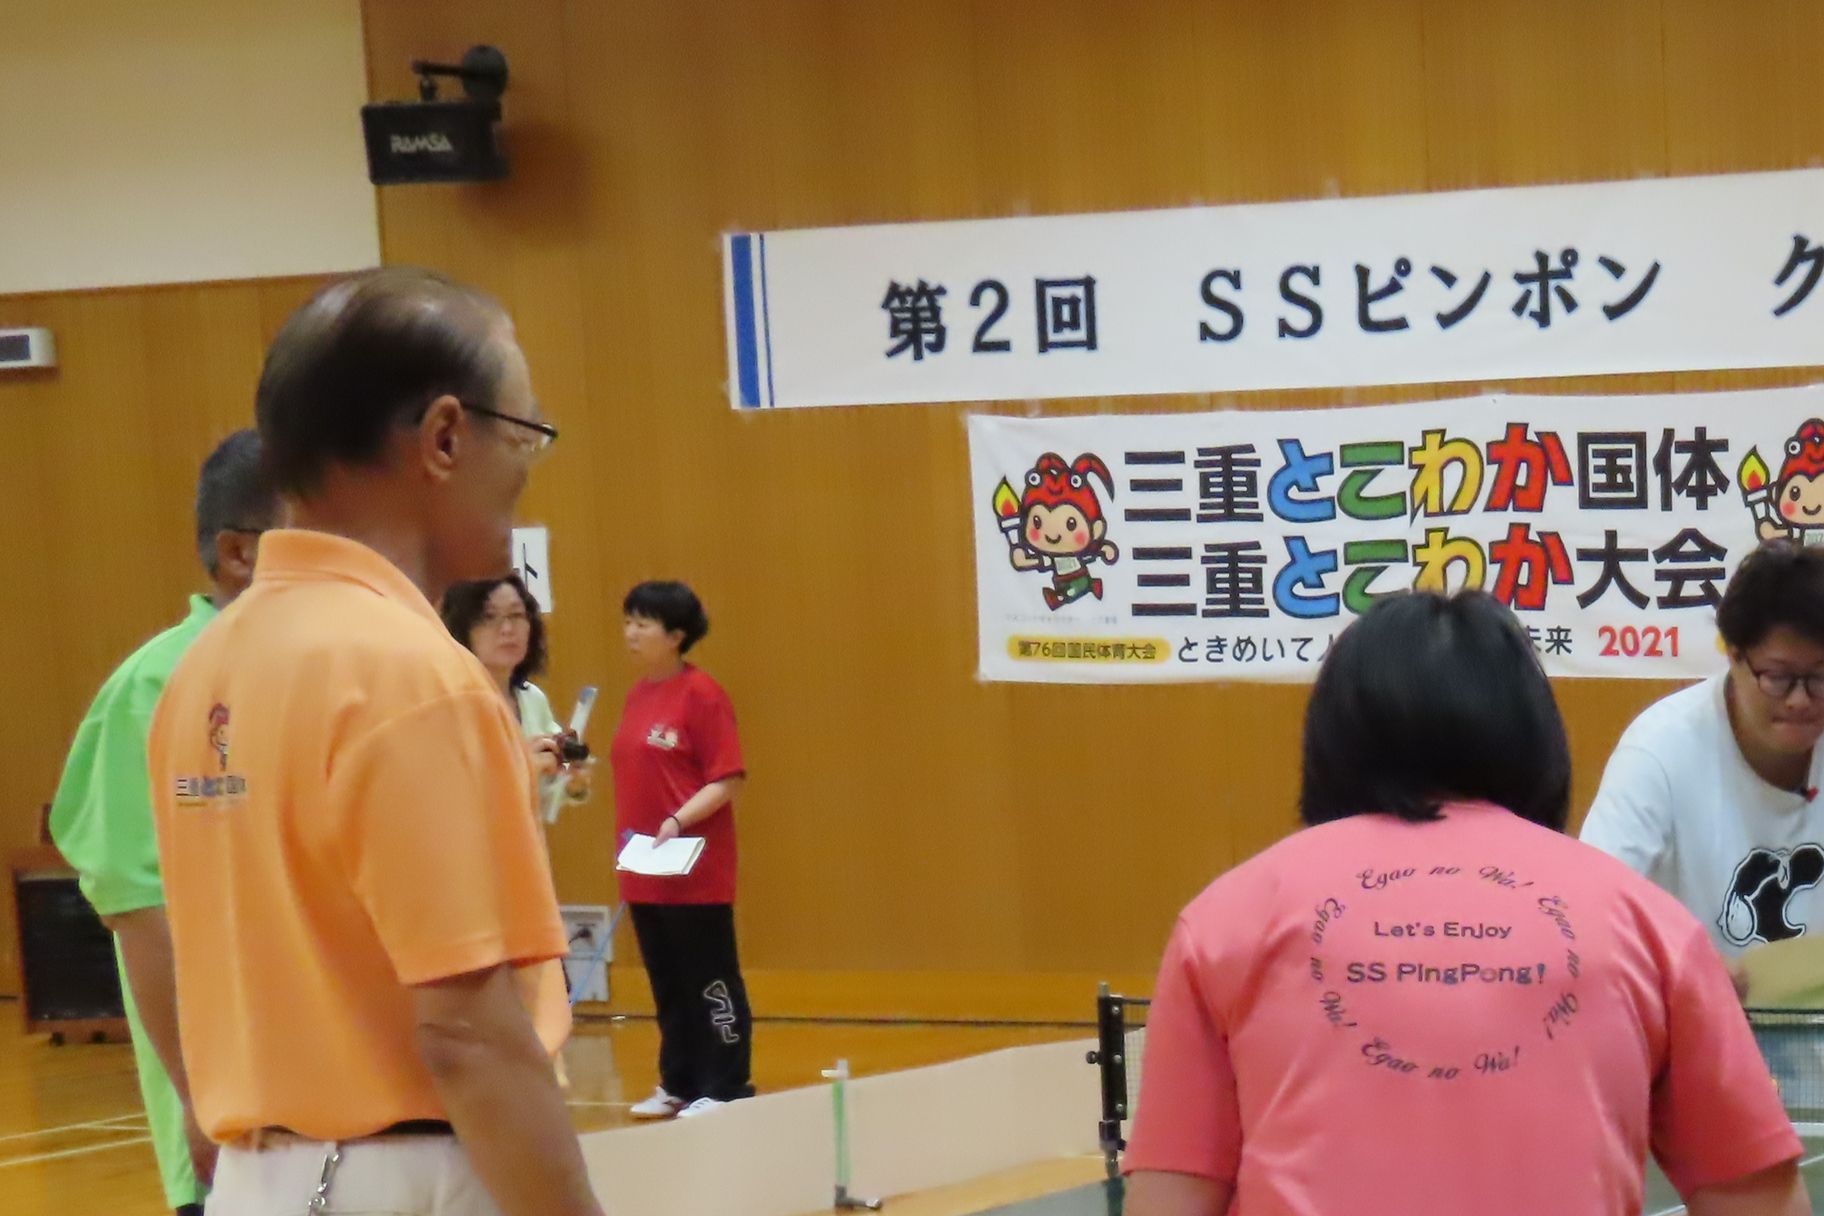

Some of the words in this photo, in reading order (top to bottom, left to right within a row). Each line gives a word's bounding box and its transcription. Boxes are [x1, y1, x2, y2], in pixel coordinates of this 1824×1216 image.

[881, 274, 1100, 362] 第2回
[1198, 246, 1662, 343] SSピンポン
[1124, 421, 1731, 526] 三重とこわか国体
[1130, 521, 1729, 621] 三重とこわか大会
[1597, 624, 1680, 657] 2021
[1356, 865, 1417, 890] Egao
[1429, 865, 1461, 877] no
[1373, 921, 1436, 938] Let's
[1443, 921, 1513, 941] Enjoy
[1310, 956, 1325, 982] no
[1346, 962, 1387, 984] SS
[1396, 962, 1547, 986] PingPong!
[1567, 949, 1581, 979] no
[1427, 1065, 1460, 1080] no
